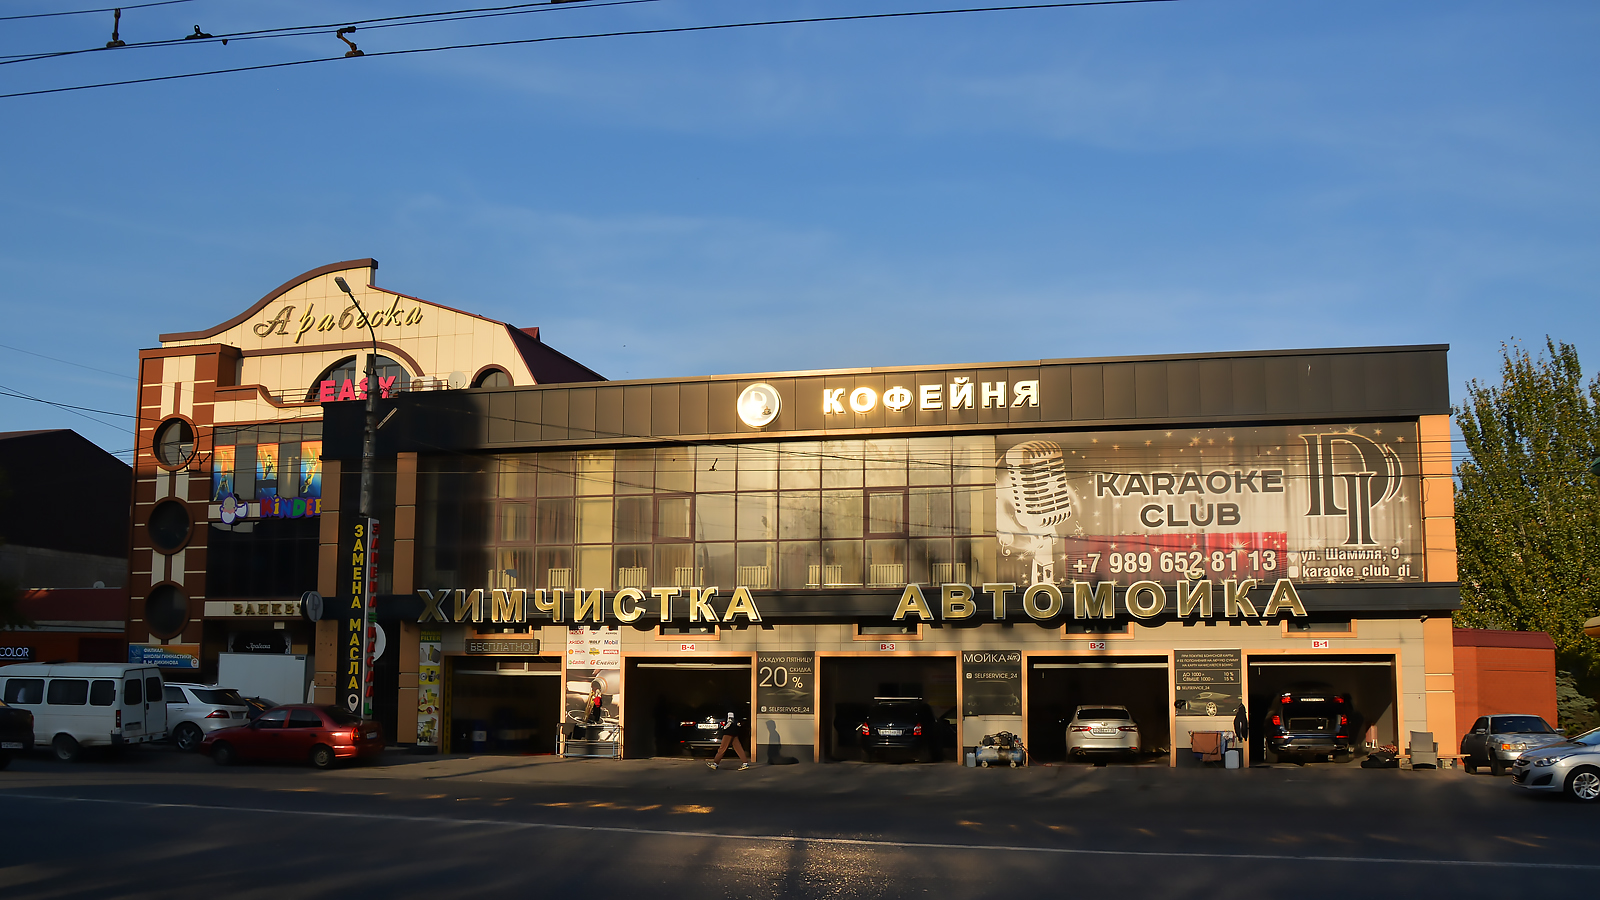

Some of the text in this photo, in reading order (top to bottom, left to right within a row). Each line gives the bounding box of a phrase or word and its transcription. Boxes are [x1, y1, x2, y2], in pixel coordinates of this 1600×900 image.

[253, 295, 424, 344] Арабеска
[823, 377, 1040, 415] КОФЕЙНЯ
[1096, 469, 1285, 498] KARAOKE
[1140, 503, 1241, 528] CLUB
[1073, 550, 1277, 573] +7 989 652 81 13
[1301, 546, 1400, 564] ул. Шамиля, 9
[347, 524, 364, 690] ЗАМЕНА МАСЛА
[417, 586, 763, 624] ХИМЧИСТКА
[892, 569, 1308, 621] АВТОМОЙКА
[963, 652, 1007, 663] МОЙКА
[759, 666, 788, 688] 20
[792, 676, 804, 688] %
